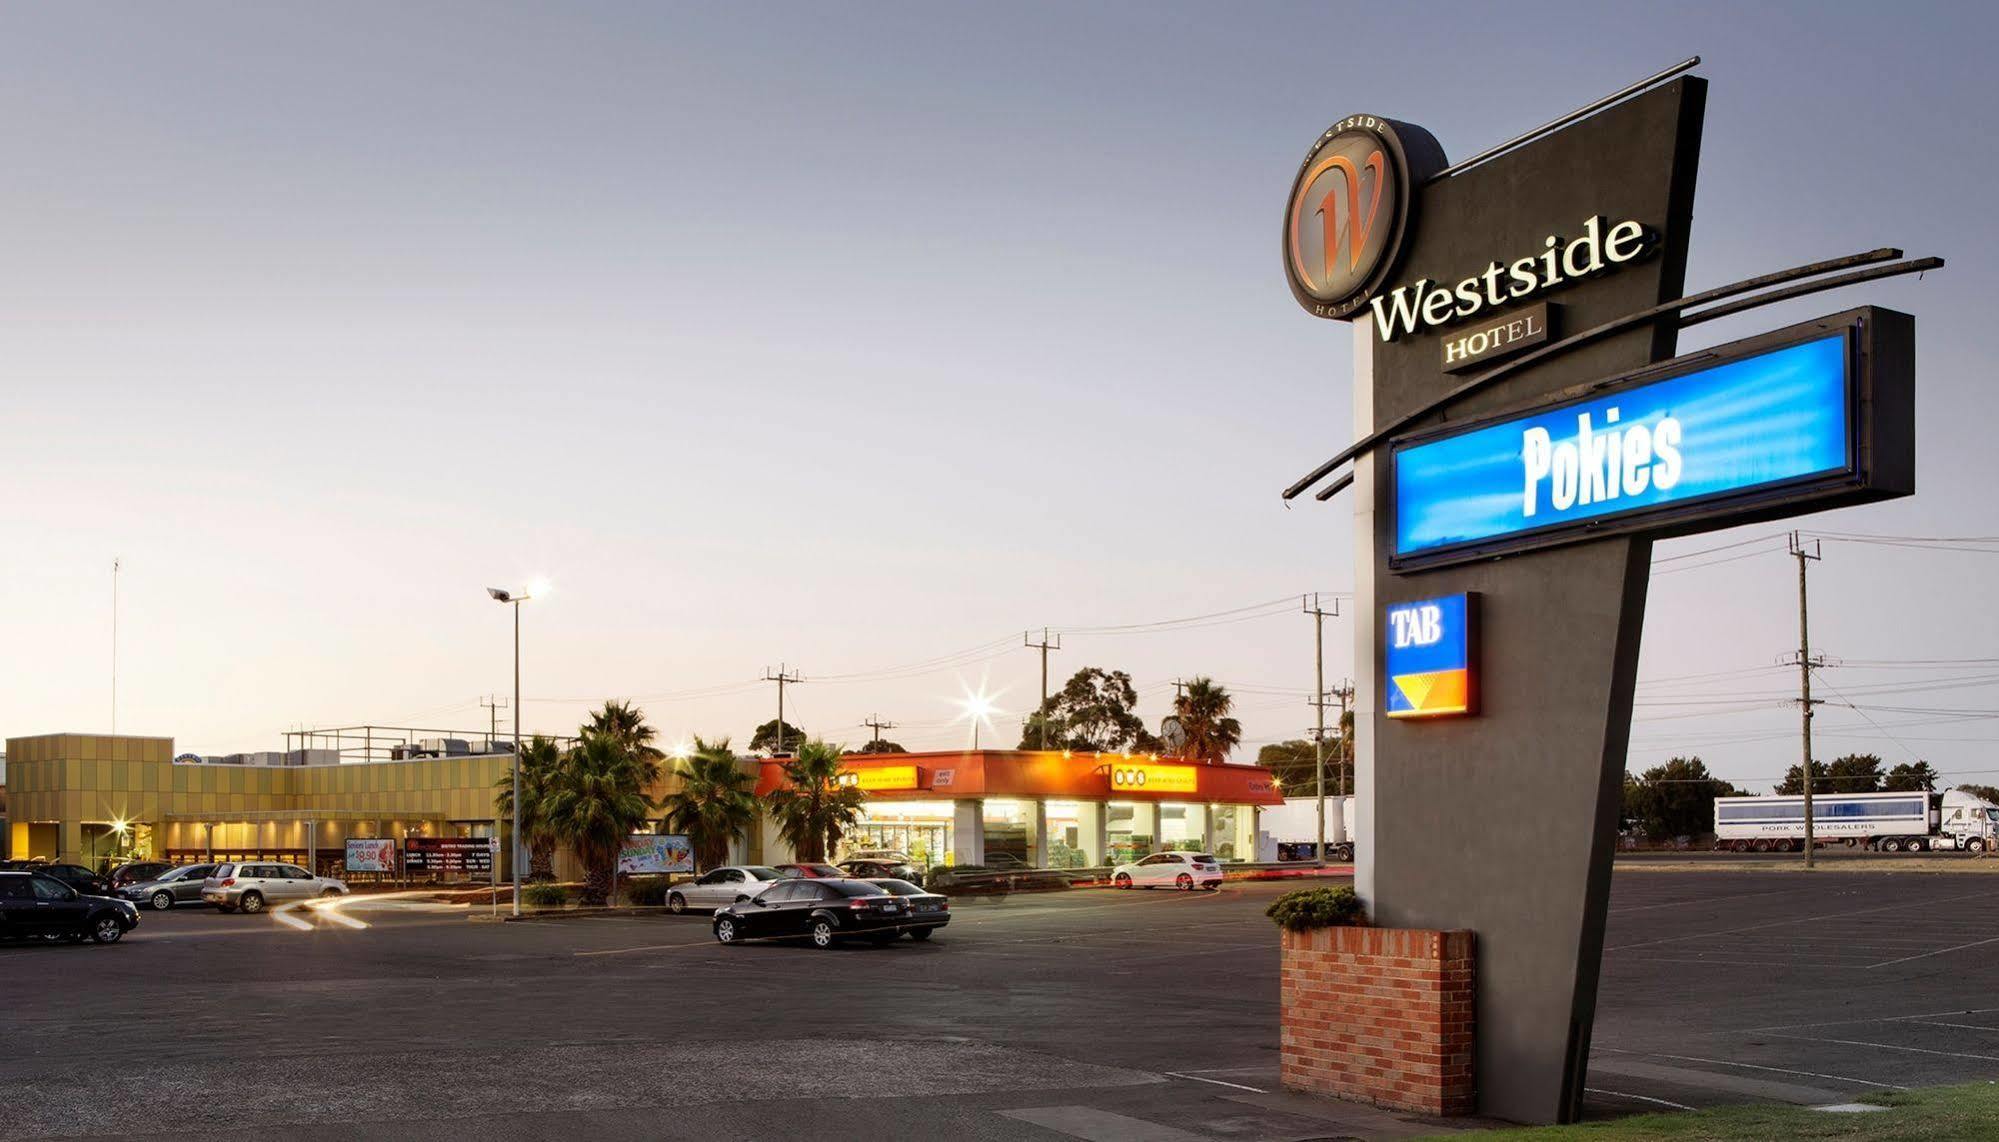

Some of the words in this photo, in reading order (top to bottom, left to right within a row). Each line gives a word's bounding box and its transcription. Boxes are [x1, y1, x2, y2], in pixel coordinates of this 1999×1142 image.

[1370, 215, 1644, 342] Westside
[1315, 289, 1370, 317] HOTEL
[1446, 316, 1543, 364] HOTEL
[1523, 406, 1683, 517] Pokies
[1391, 605, 1442, 649] TAB
[1795, 823, 1876, 831] WOLESALERS
